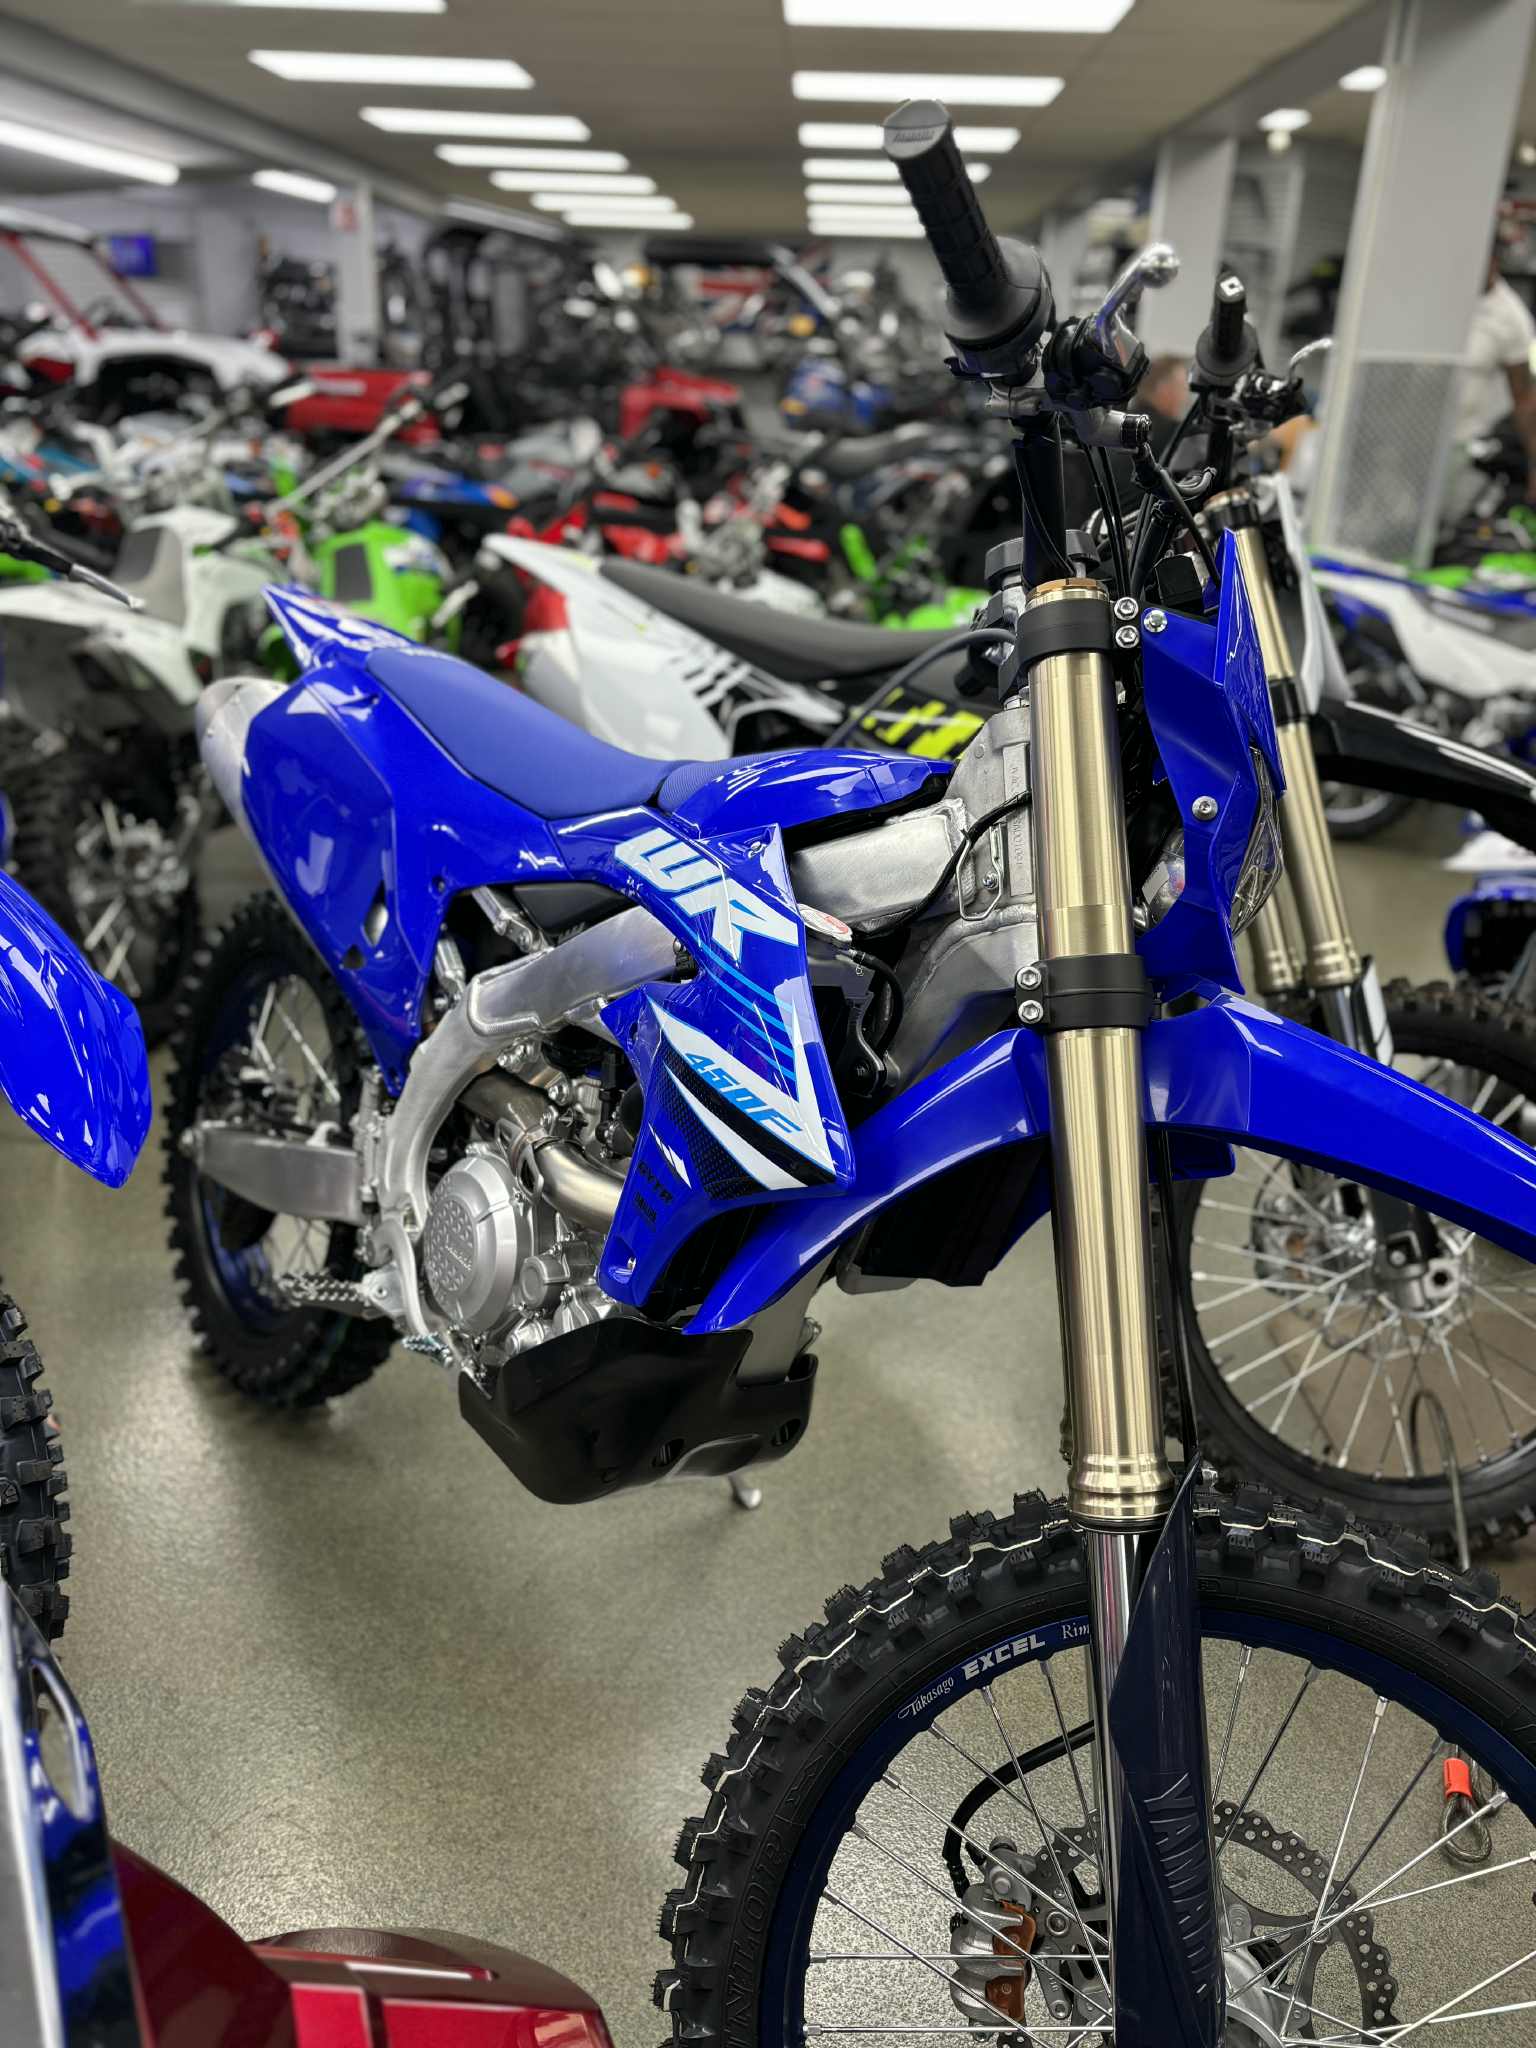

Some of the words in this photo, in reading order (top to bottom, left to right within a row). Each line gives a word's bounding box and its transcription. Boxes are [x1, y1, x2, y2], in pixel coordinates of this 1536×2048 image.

[613, 826, 799, 967] WR
[684, 1051, 803, 1137] 450F
[897, 1676, 955, 1719] Takasago
[960, 1633, 1046, 1681] EXCEL
[1143, 1771, 1216, 2003] YAMAHA
